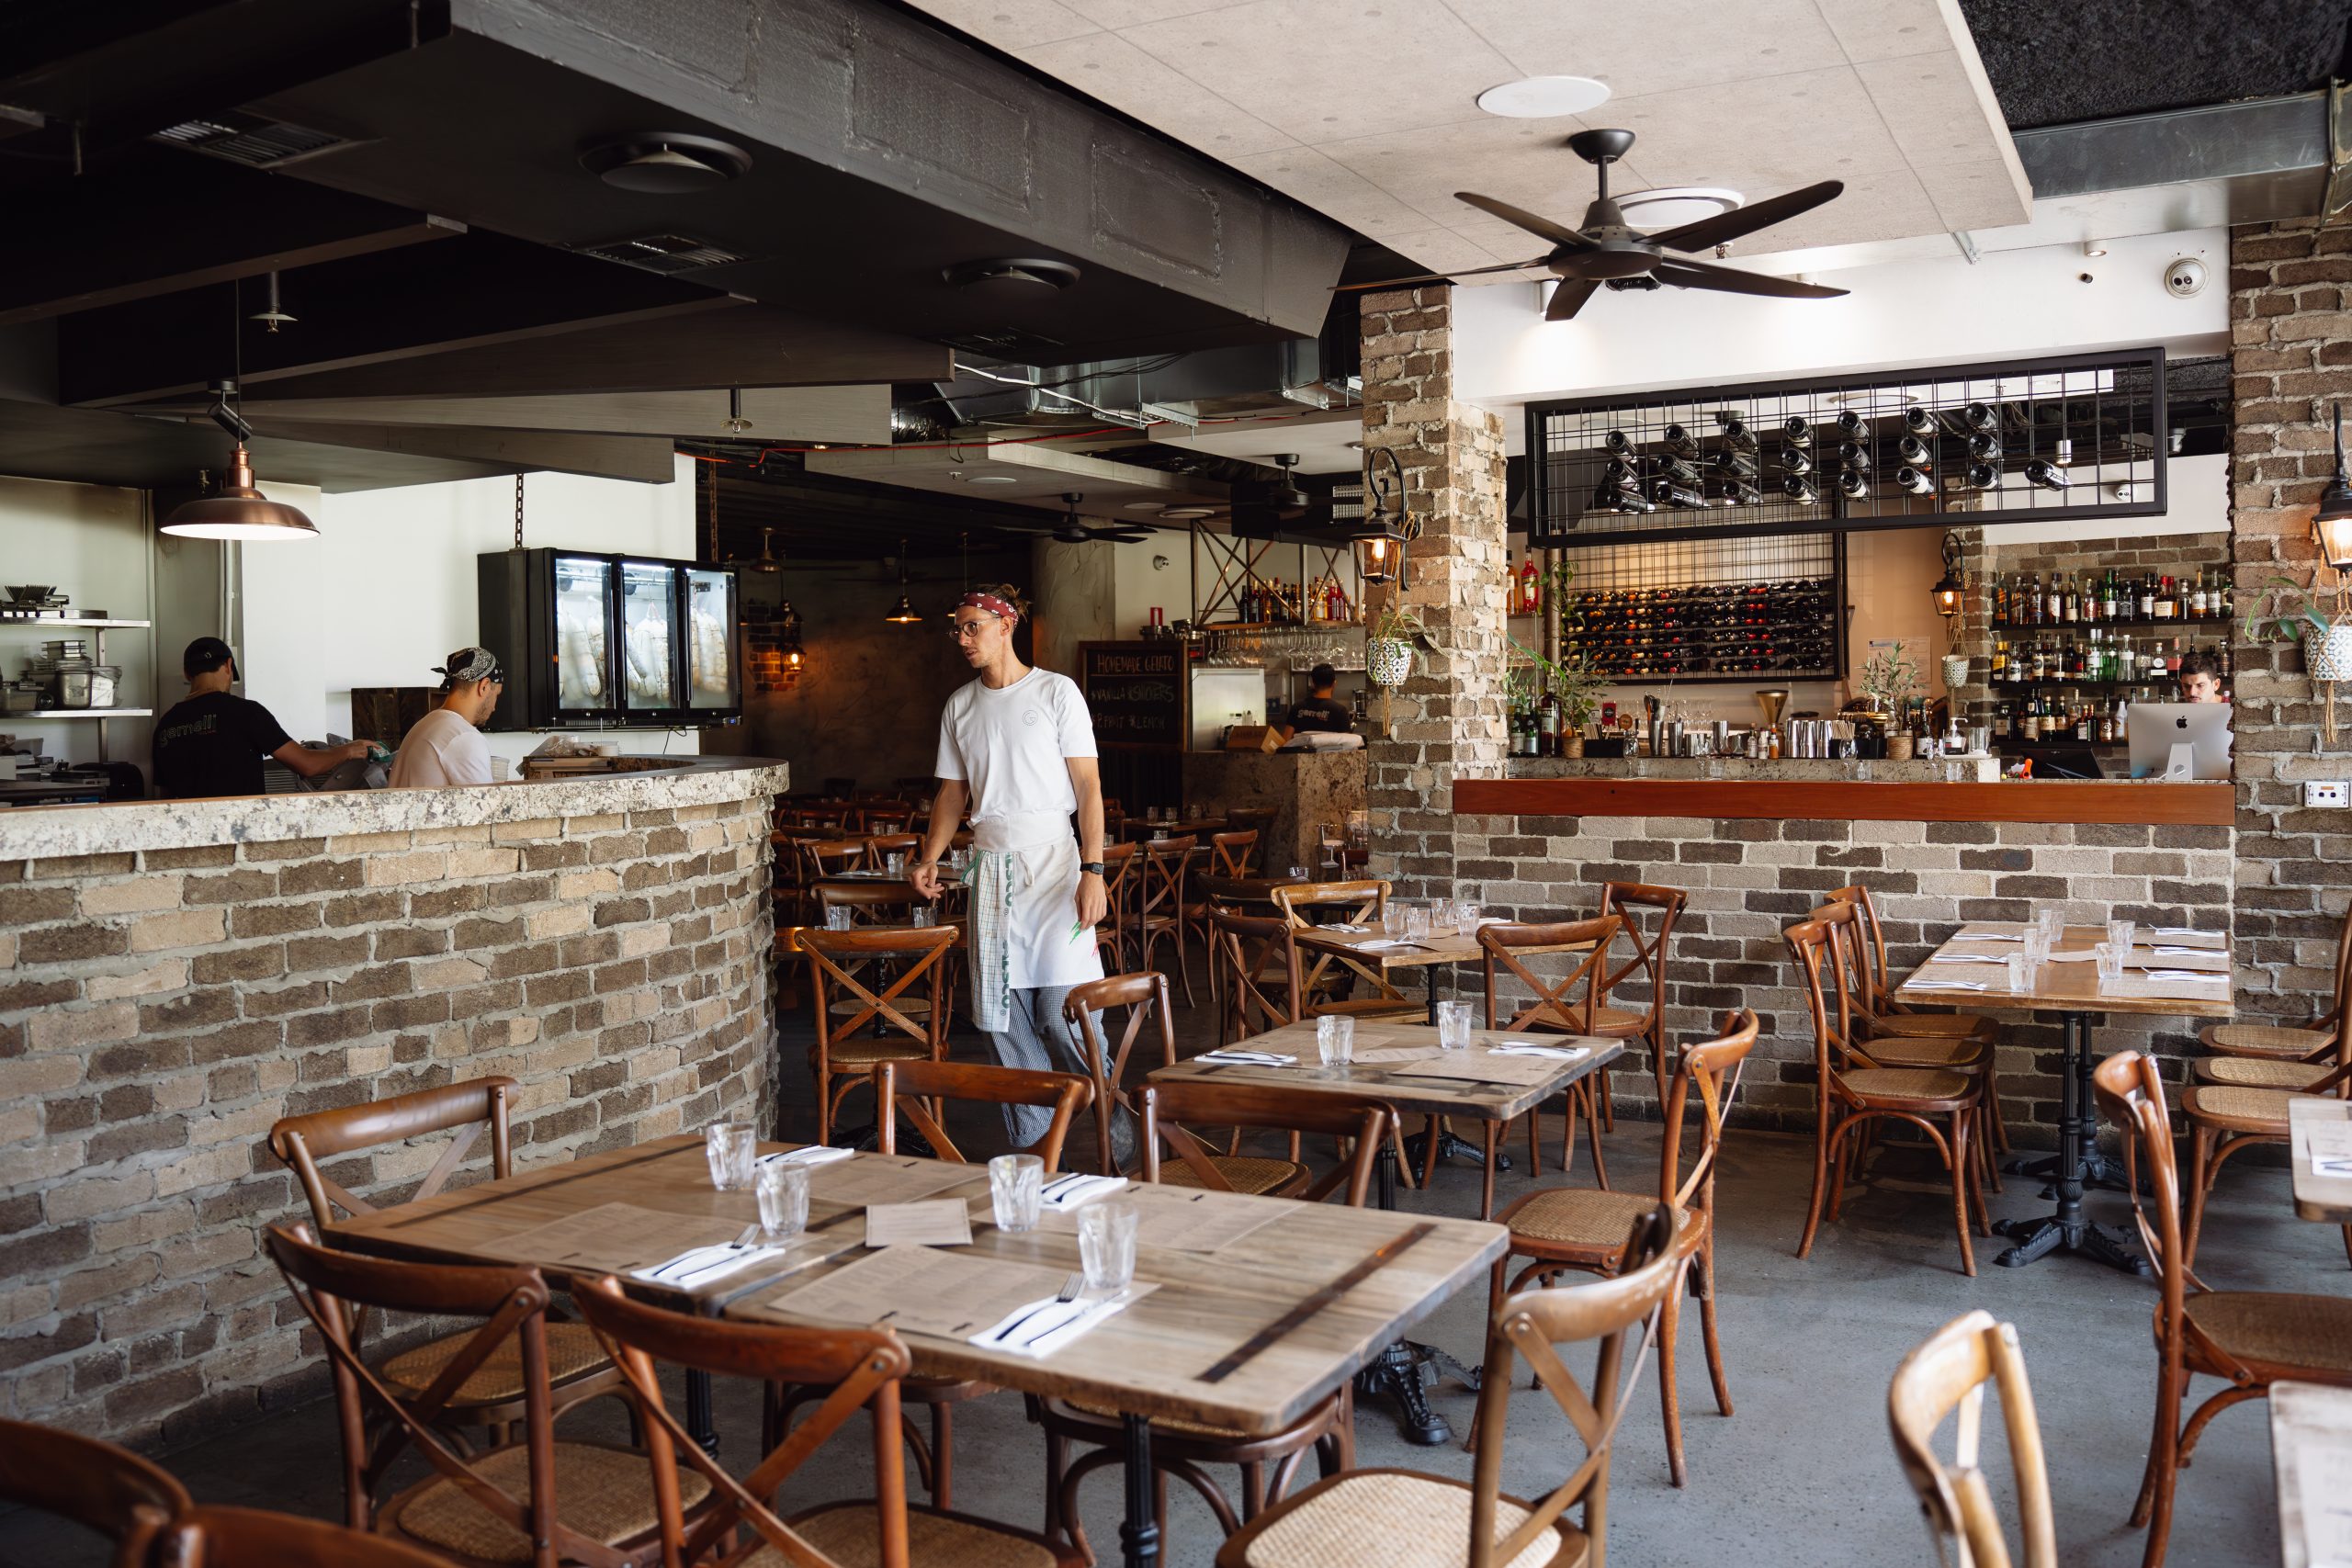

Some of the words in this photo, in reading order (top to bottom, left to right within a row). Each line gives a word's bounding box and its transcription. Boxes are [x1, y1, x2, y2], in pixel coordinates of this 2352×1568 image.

[1097, 653, 1141, 673] HOMEMADE
[1145, 654, 1174, 671] GELATO
[160, 713, 217, 747] gemelli
